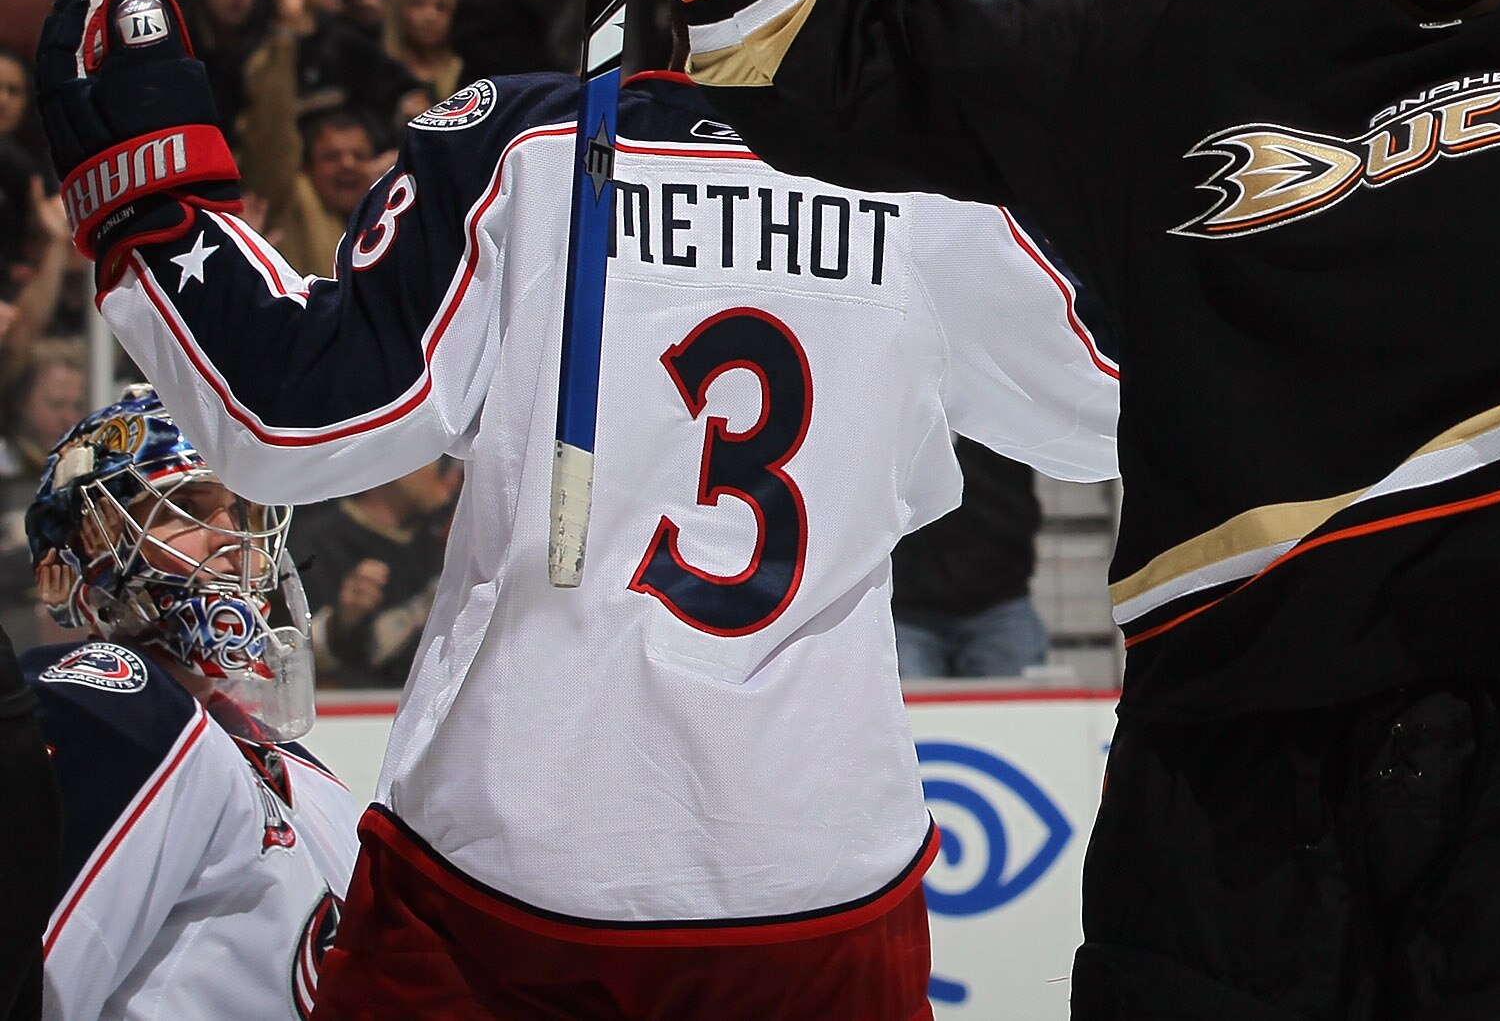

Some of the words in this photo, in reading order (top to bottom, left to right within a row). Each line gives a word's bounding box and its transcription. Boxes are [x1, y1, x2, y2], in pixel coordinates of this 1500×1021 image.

[352, 171, 417, 271] 3
[606, 179, 900, 285] METHOT
[626, 306, 813, 638] 3
